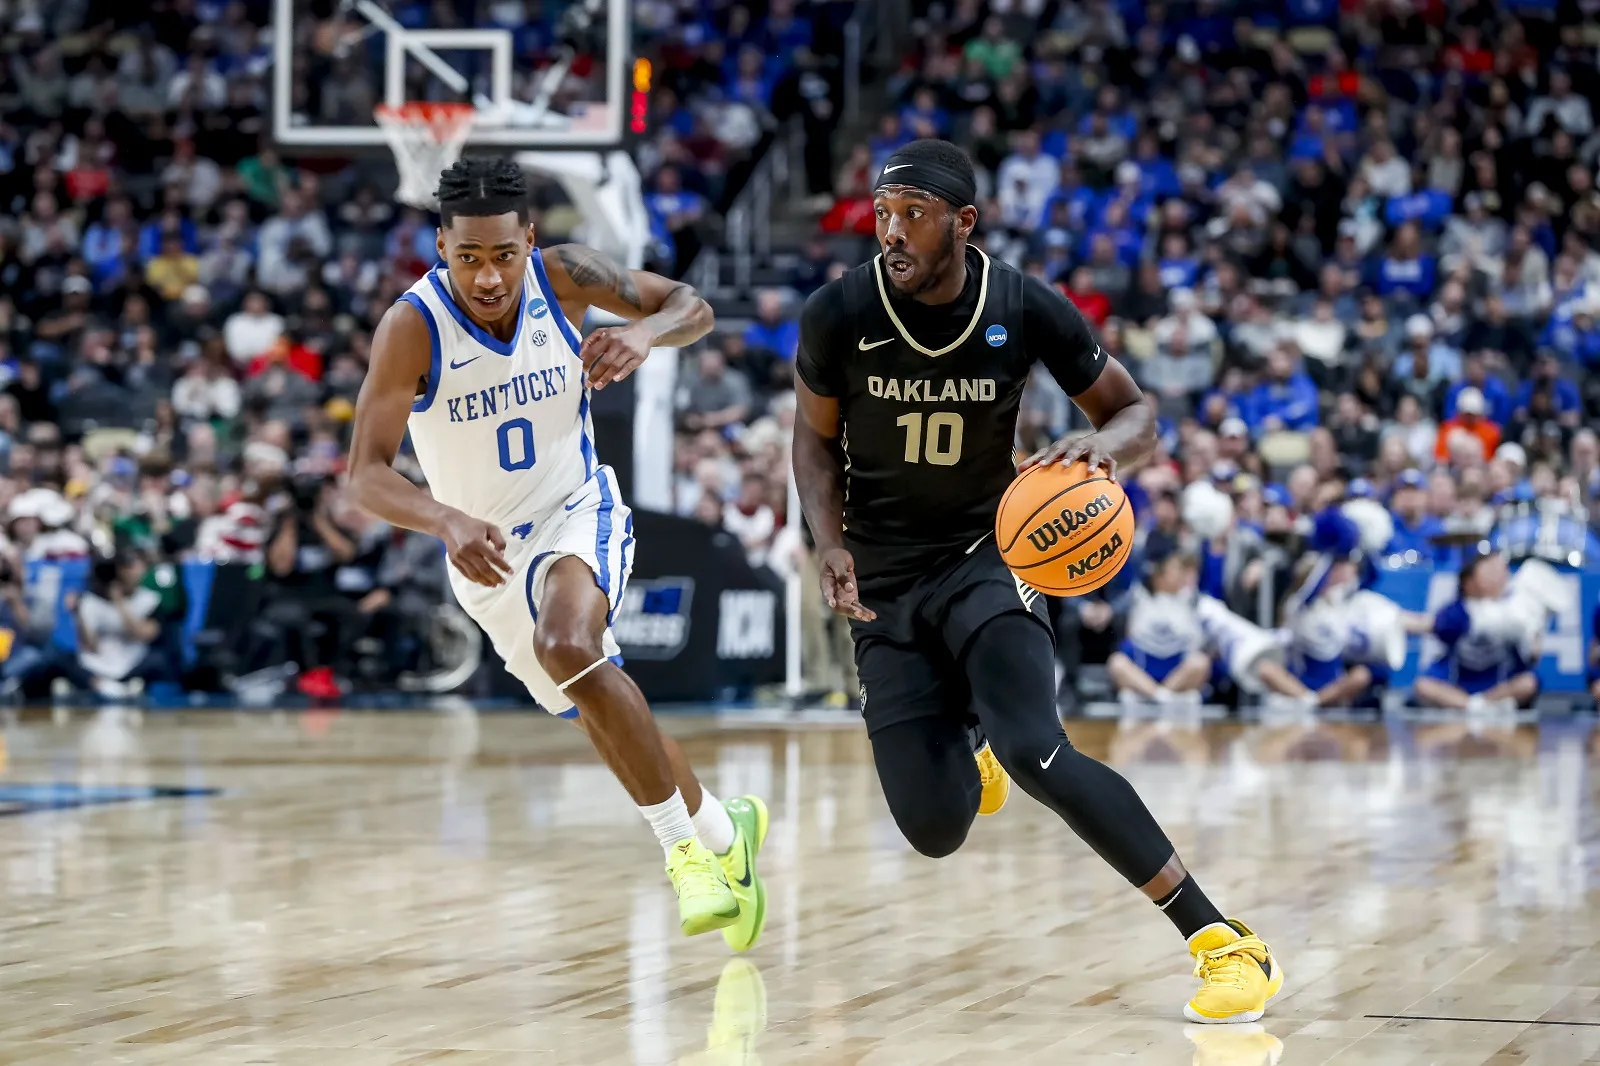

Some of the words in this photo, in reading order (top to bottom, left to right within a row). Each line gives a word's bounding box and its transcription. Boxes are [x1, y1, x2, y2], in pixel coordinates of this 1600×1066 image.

[533, 331, 547, 345] SEC
[988, 333, 1006, 342] NCAA
[447, 365, 566, 423] KENTUCKY
[867, 375, 996, 402] OAKLAND
[496, 417, 536, 472] 0
[896, 411, 964, 466] 10
[1026, 494, 1114, 552] Wilson
[1066, 532, 1123, 579] NCAA
